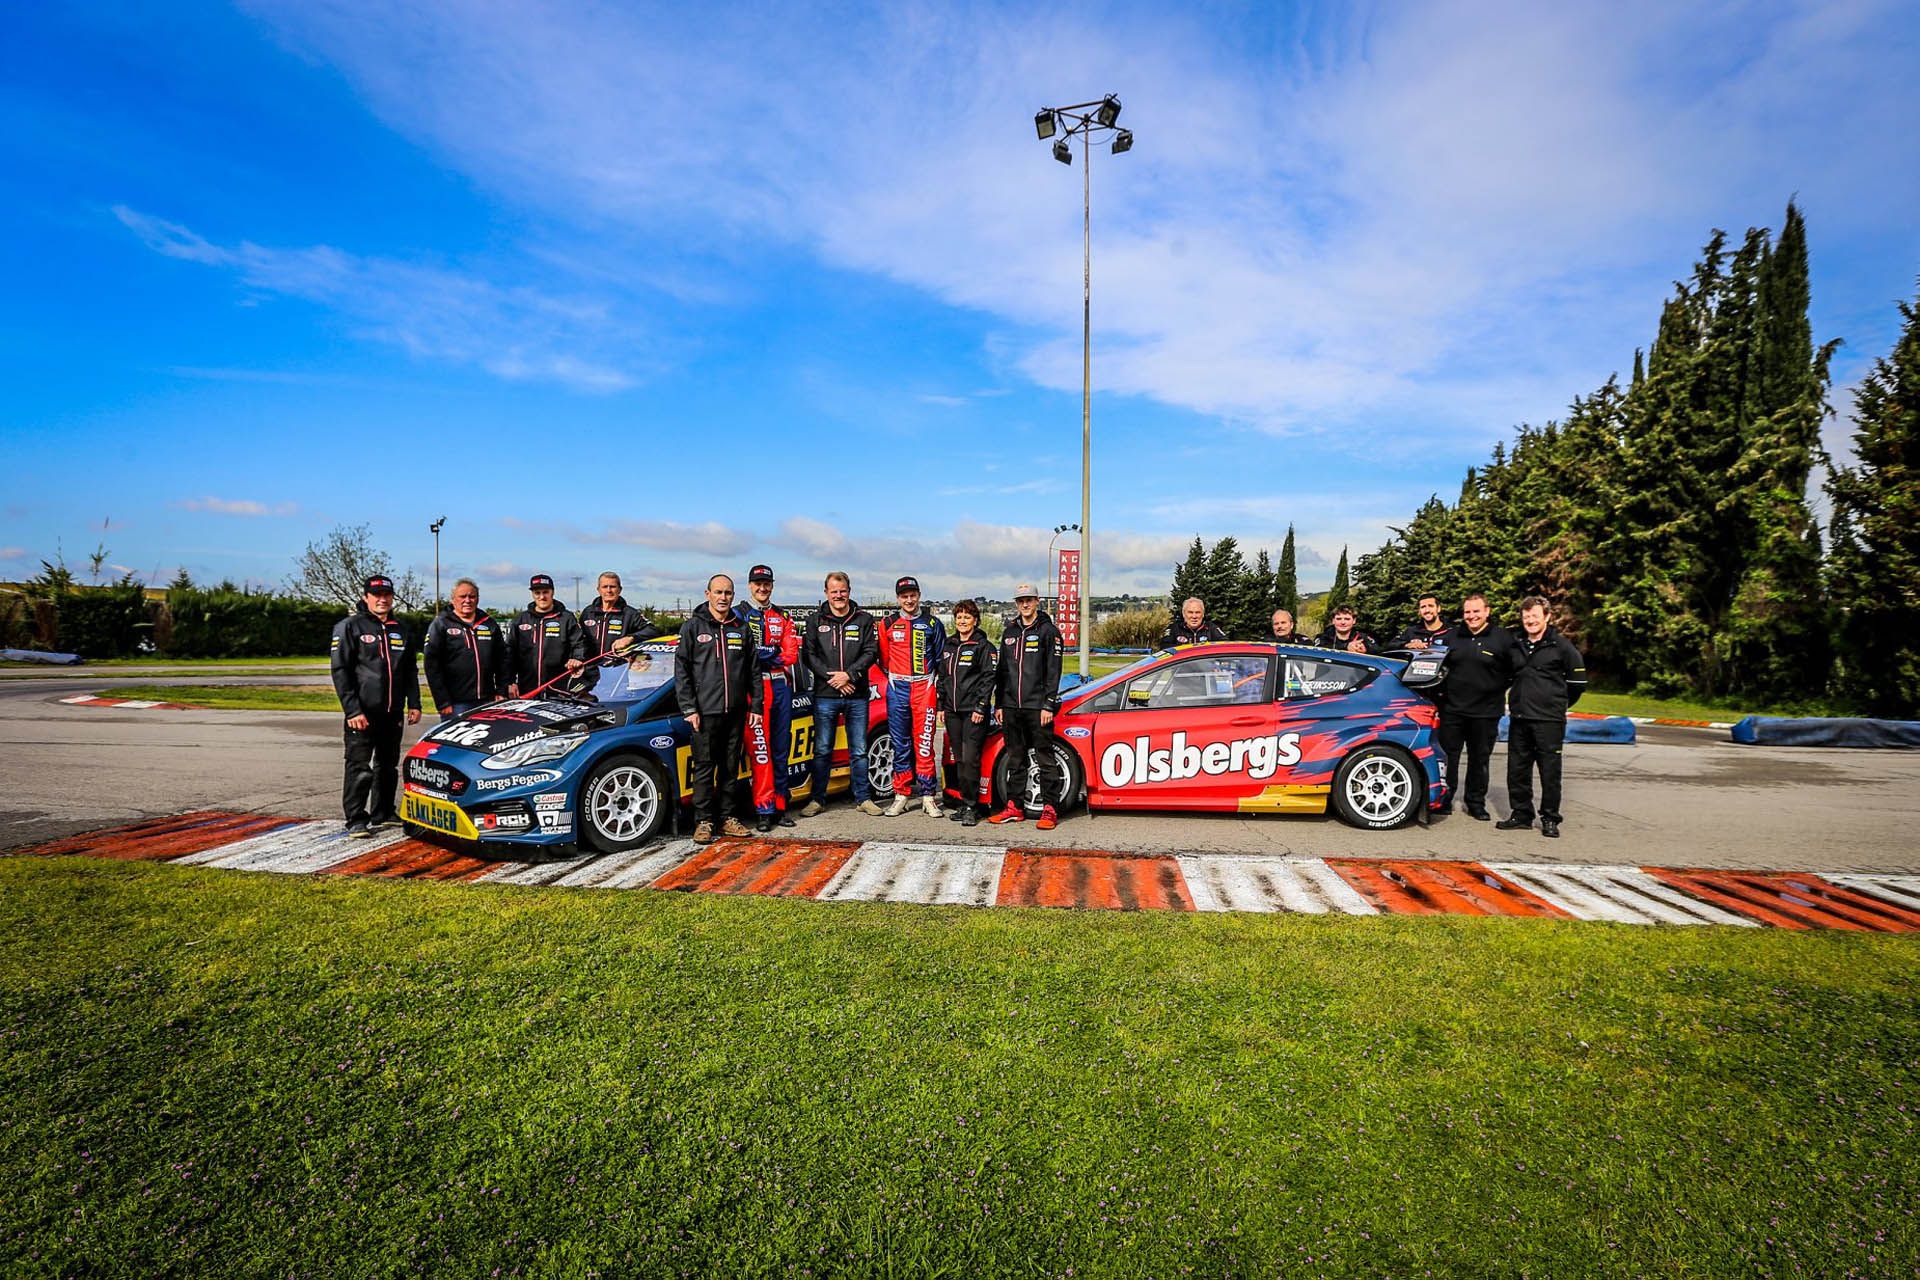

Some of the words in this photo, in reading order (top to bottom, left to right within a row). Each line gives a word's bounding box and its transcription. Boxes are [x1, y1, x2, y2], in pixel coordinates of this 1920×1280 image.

[1069, 555, 1078, 640] CATALUNYA
[653, 737, 672, 747] Ford
[919, 707, 935, 757] Olsbergs
[410, 759, 449, 788] Olsbergs
[1101, 731, 1301, 787] Olsbergs
[476, 780, 511, 790] Bergs
[511, 773, 550, 786] Fegen
[535, 802, 566, 811] EDGE
[584, 777, 600, 822] COOPER
[1368, 812, 1407, 827] COOPER
